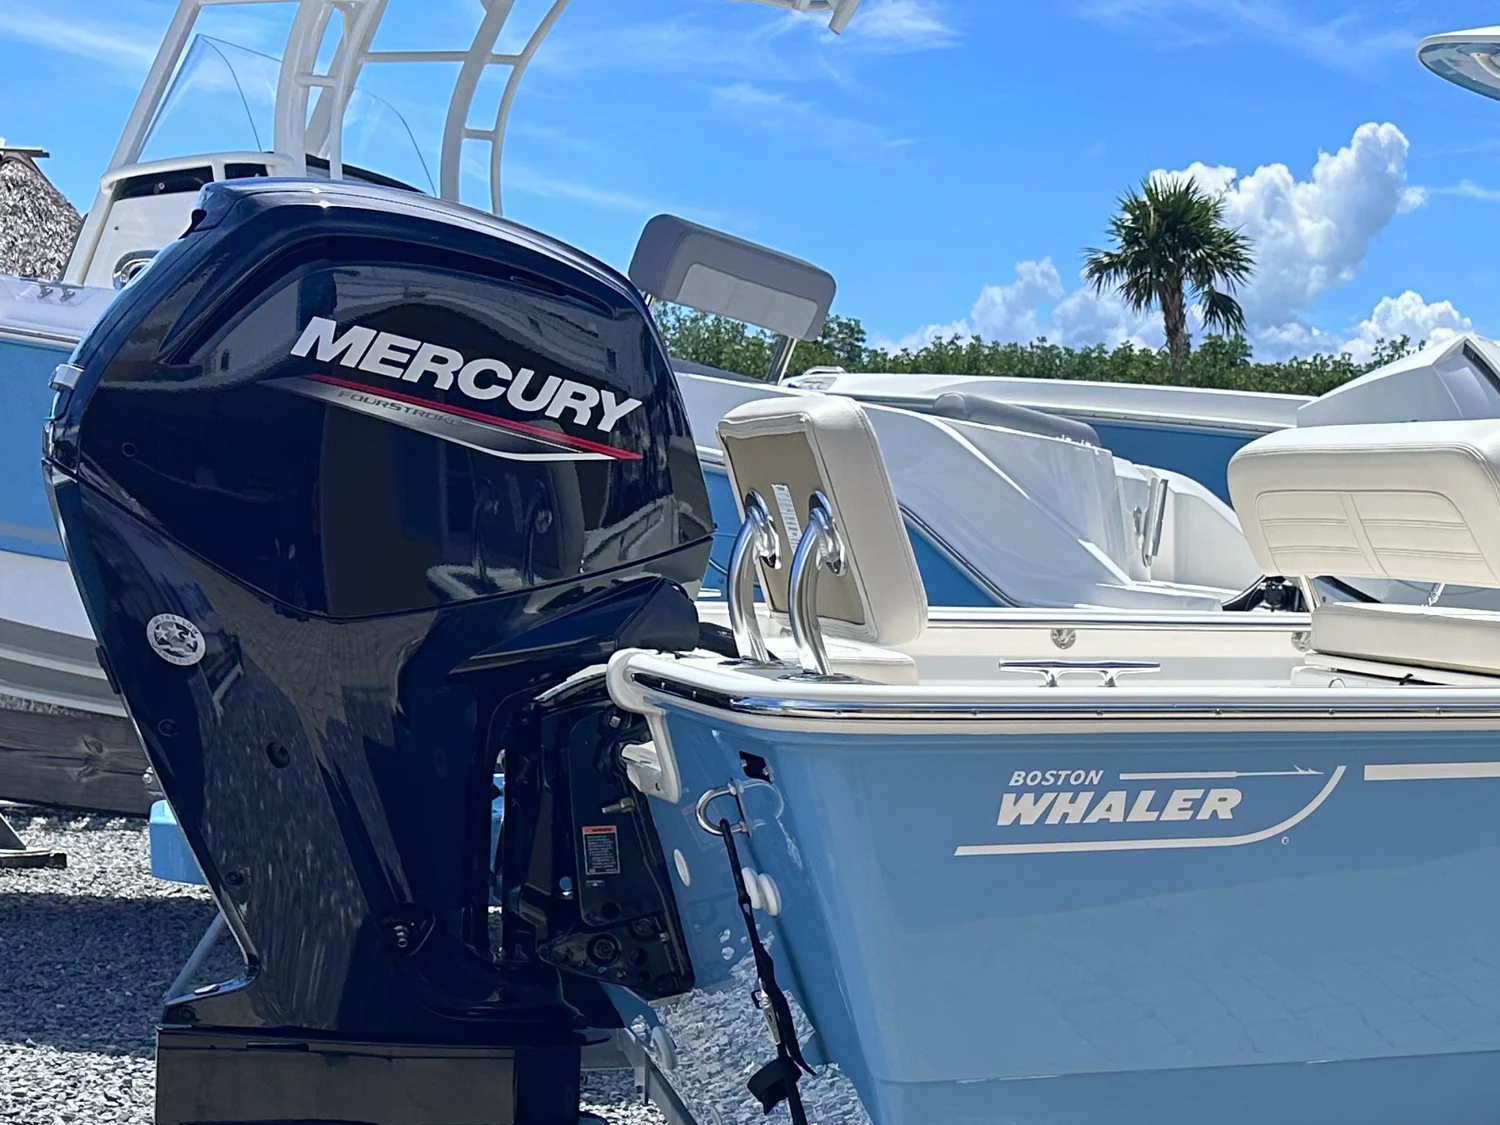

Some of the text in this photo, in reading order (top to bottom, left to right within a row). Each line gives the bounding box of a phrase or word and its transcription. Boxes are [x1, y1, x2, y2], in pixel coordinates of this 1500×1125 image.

[290, 316, 643, 433] MERCURY
[337, 390, 459, 426] FOURSTROKE
[1008, 769, 1104, 787] BOSTON
[996, 788, 1243, 827] WHALER
